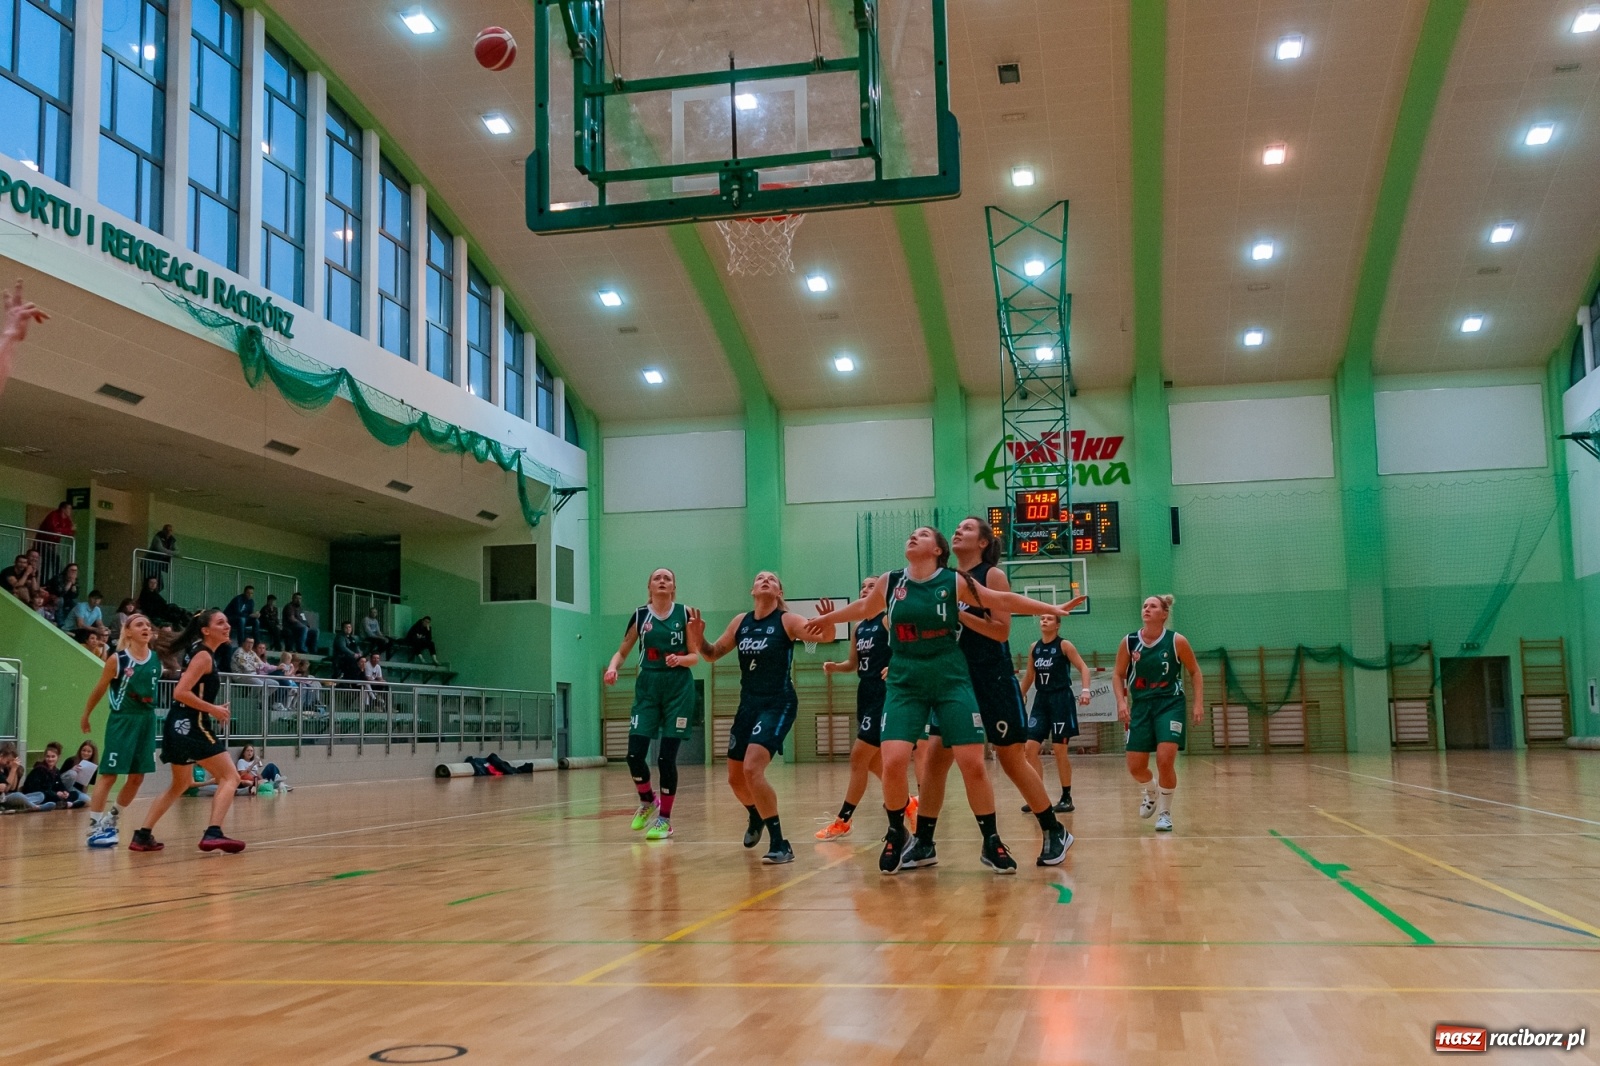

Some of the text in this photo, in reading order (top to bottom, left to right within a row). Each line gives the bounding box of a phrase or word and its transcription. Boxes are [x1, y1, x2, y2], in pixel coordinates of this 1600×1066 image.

[87, 214, 94, 245] I
[101, 221, 208, 298] REKREACJI
[213, 276, 295, 339] RACIBÓRZ
[73, 496, 84, 507] F
[1027, 505, 1049, 519] 0.0
[1075, 539, 1092, 551] 33
[936, 602, 947, 622] 4
[670, 631, 684, 646] 24
[1161, 661, 1170, 676] 3
[1039, 672, 1050, 685] 17
[996, 720, 1008, 738] 9
[1053, 722, 1065, 735] 17
[108, 752, 118, 767] 5
